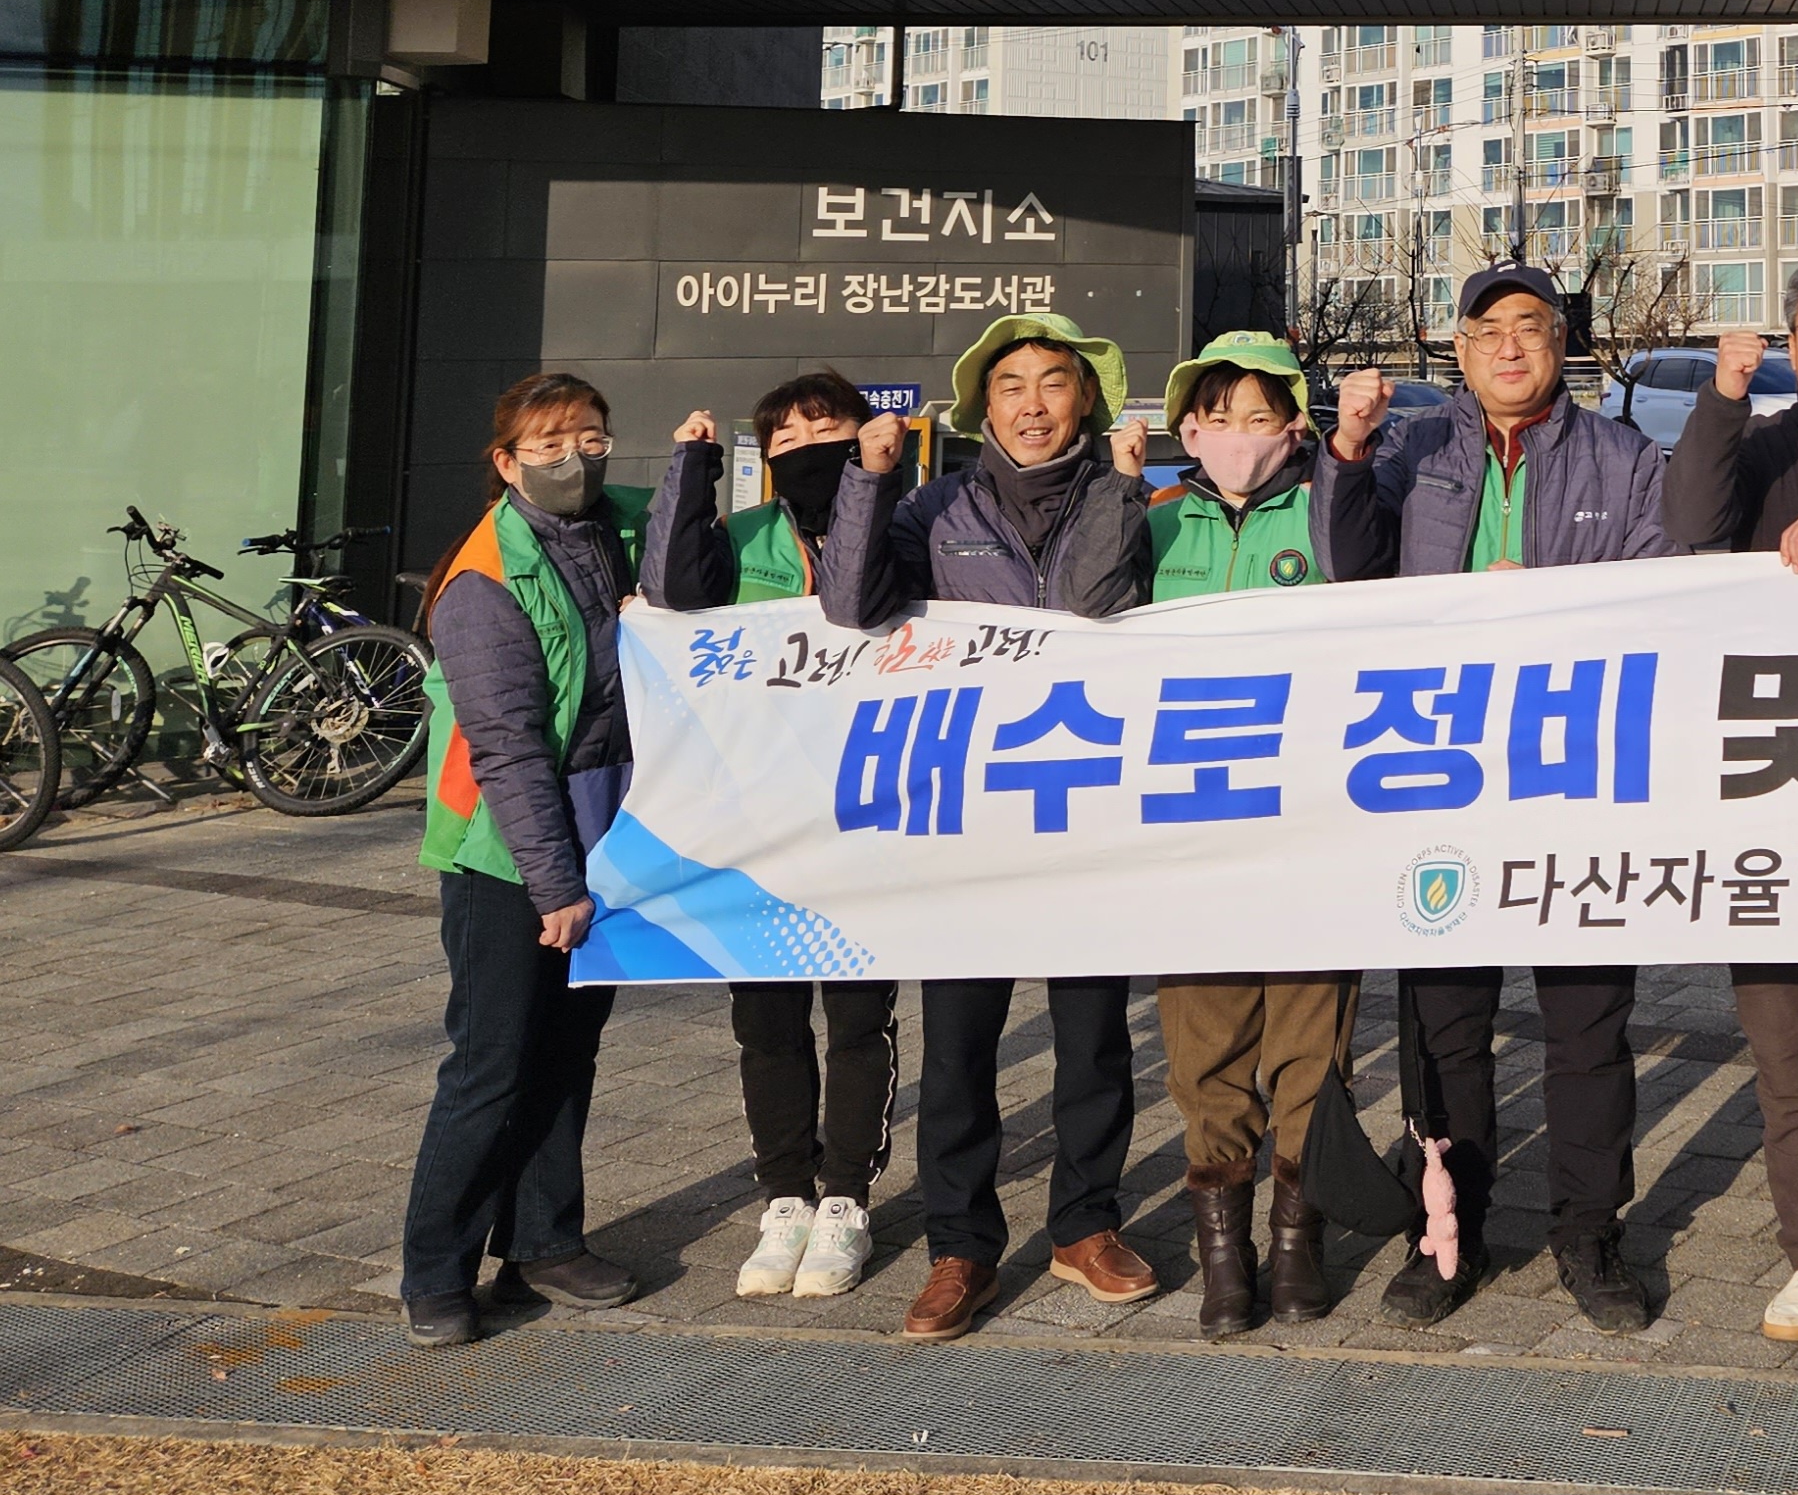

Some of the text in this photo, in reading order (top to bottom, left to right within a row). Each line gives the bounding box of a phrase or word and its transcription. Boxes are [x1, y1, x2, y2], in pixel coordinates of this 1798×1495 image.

[1076, 40, 1108, 62] 101
[811, 186, 1056, 244] 보건지소
[676, 273, 1055, 315] 아이누리 장난감도서관
[689, 622, 1056, 688] 젊은 고령! 힘 있는 고령!
[834, 672, 1292, 836] 배수로
[1343, 652, 1660, 813] 정비
[1396, 843, 1481, 909] CITIZEN CORPS ACTIVE IN DISASTER
